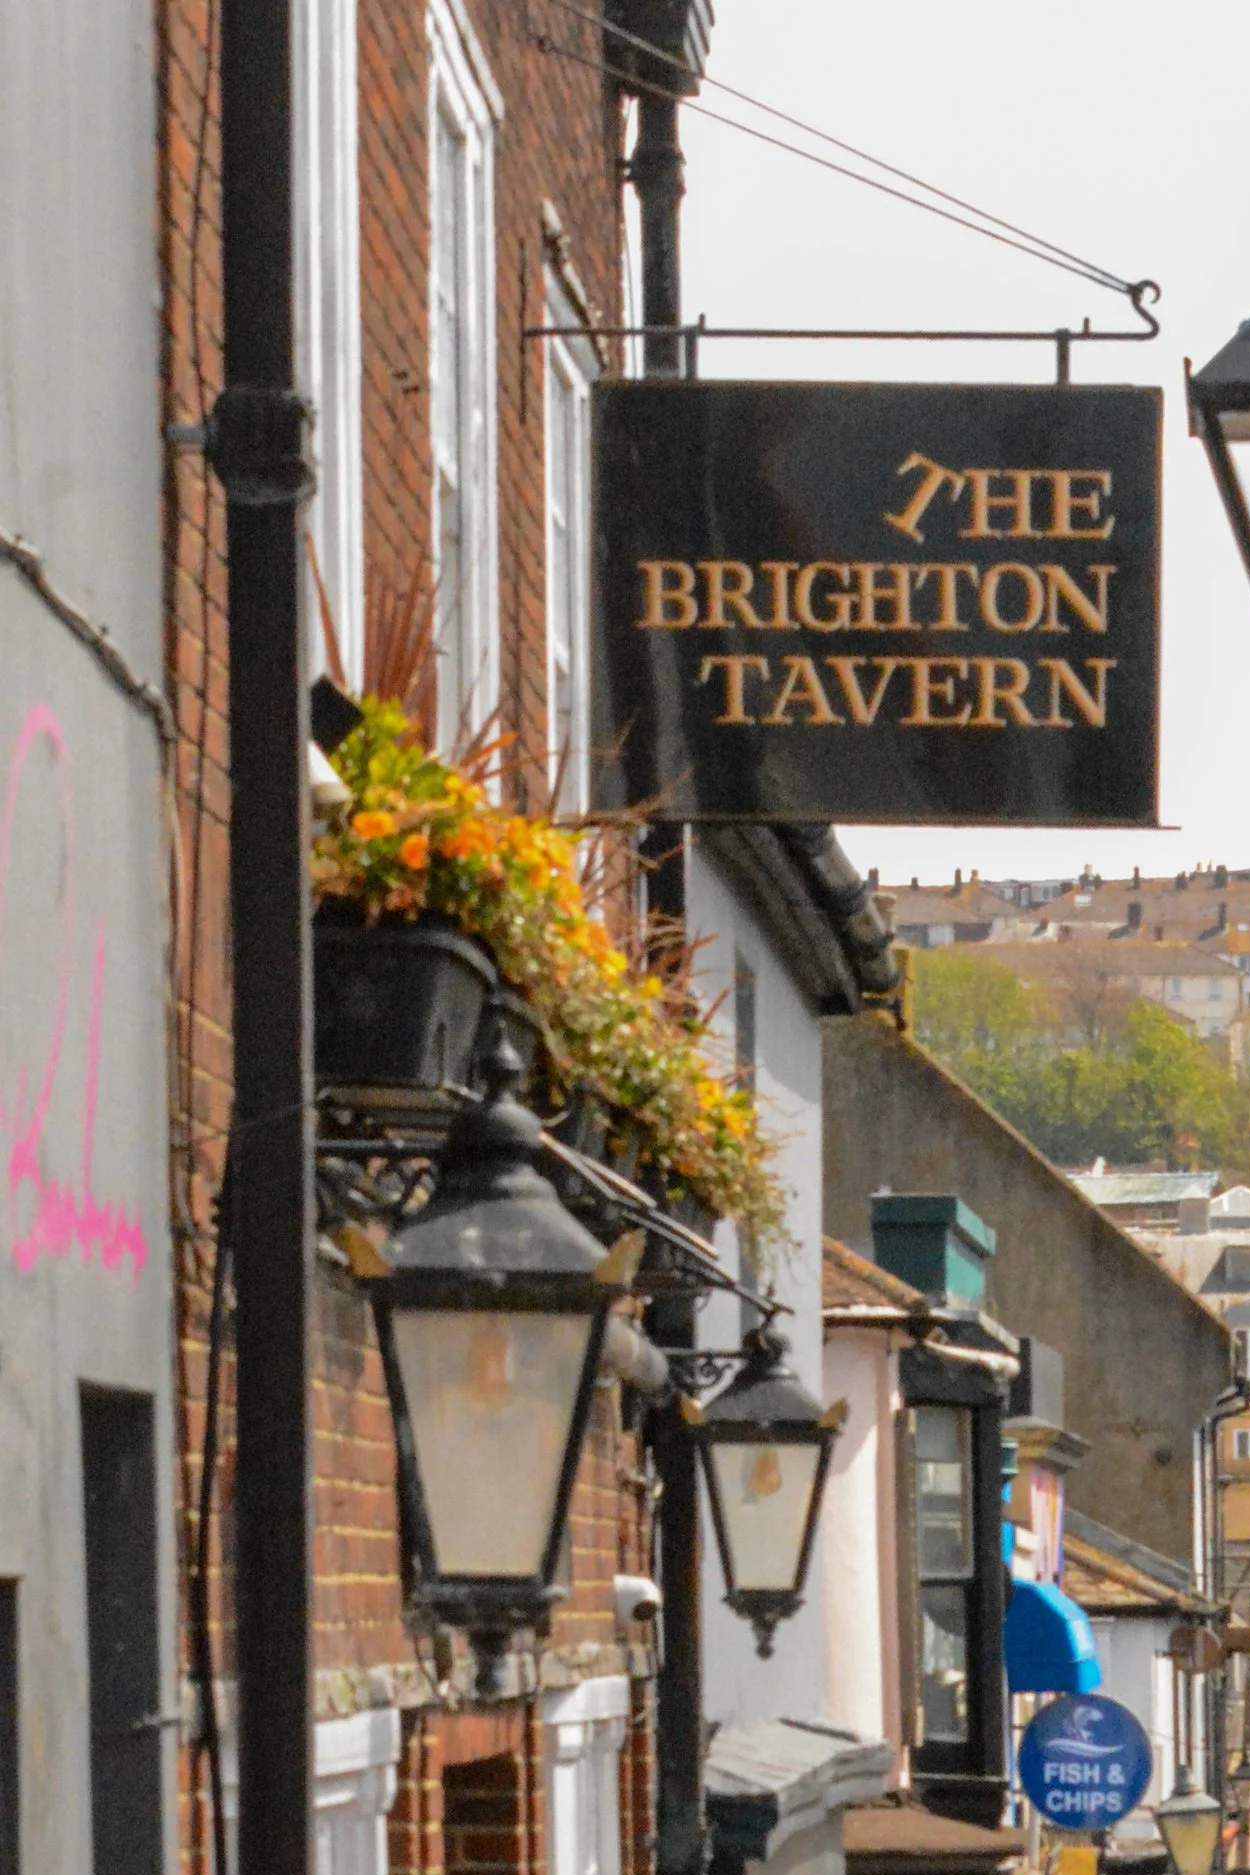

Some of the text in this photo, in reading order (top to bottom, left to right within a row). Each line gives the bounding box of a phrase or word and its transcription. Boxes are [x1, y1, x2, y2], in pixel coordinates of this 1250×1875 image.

[883, 451, 1115, 543] THE
[636, 560, 1118, 634] BRIGHTON
[695, 655, 1118, 728] TAVERN
[1043, 1762, 1125, 1785] FISH &
[1046, 1791, 1123, 1814] CHIPS
